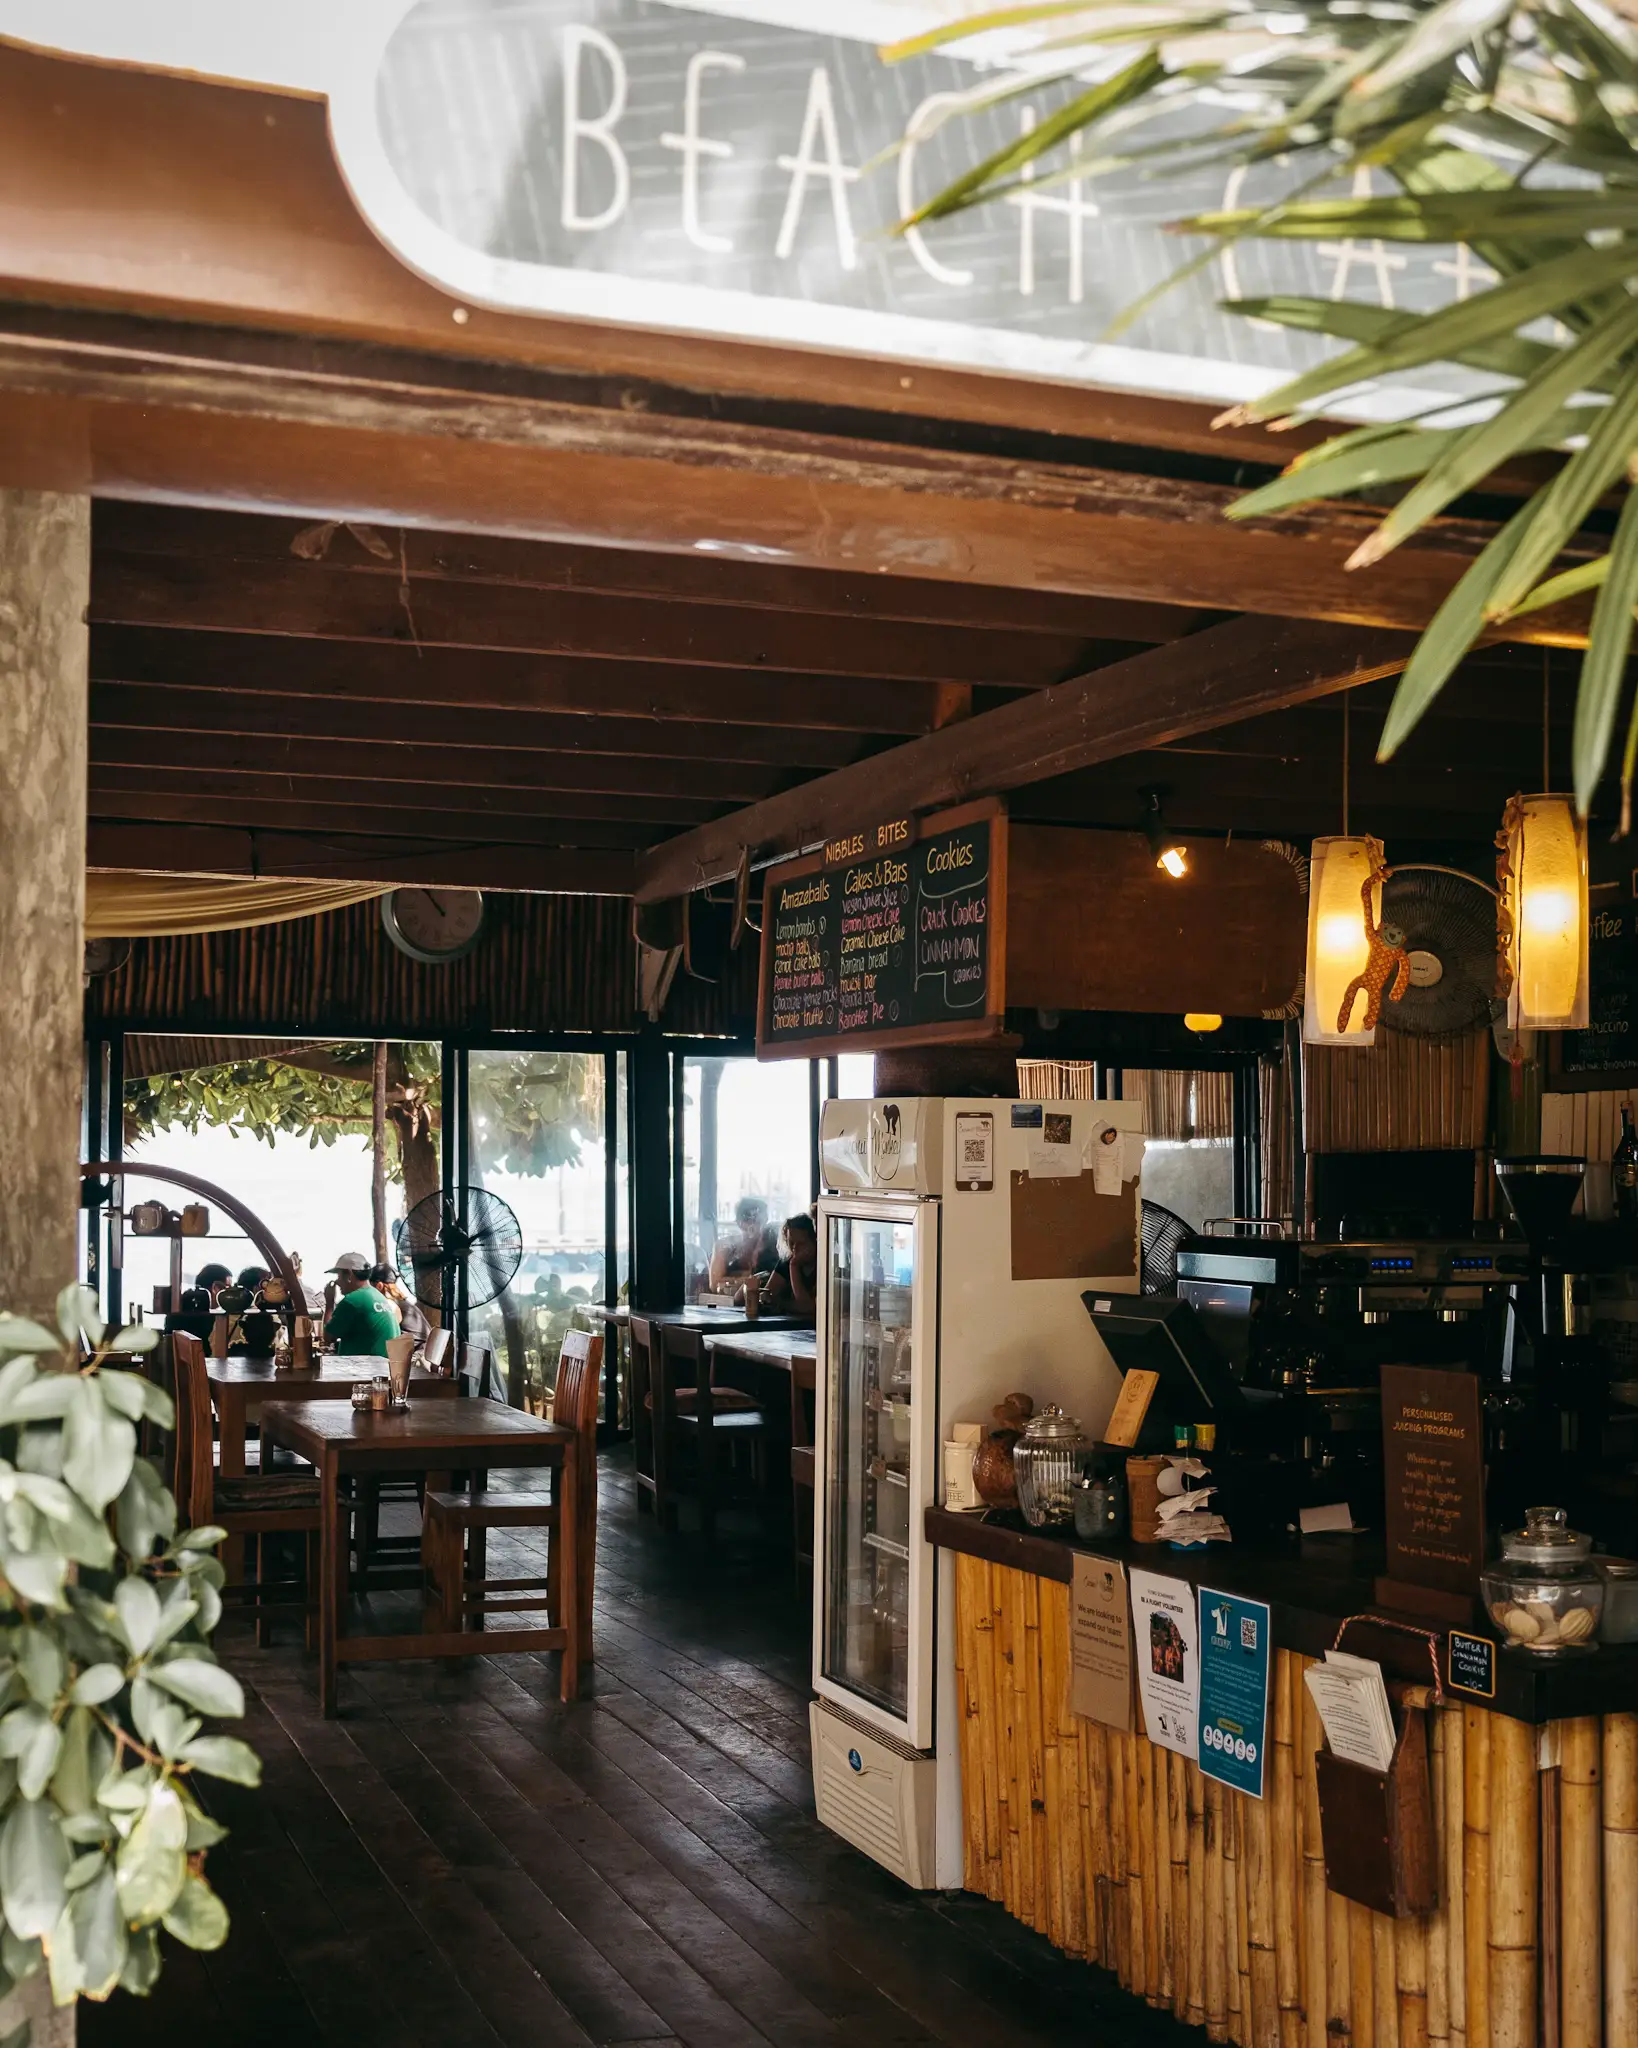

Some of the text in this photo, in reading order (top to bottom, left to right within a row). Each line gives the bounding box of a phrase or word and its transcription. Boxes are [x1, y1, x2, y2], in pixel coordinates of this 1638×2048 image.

[560, 24, 1101, 303] BEACH
[825, 834, 864, 865] NIBBLES
[878, 820, 908, 847] BITES
[926, 839, 974, 875] Cookies
[844, 860, 908, 895] Cakes & Bars
[780, 878, 830, 911] Amazeballs
[840, 924, 906, 954] Caramel Cheese Cake
[840, 946, 888, 977] Banana bread
[864, 972, 877, 990] bar
[872, 1002, 885, 1025] Pie
[1402, 1406, 1454, 1422] PERSONALISED
[1423, 1424, 1466, 1439] PROGRAMS
[1077, 1603, 1123, 1624] We are looking to
[1162, 1602, 1184, 1614] VOLUNTEER
[1077, 1618, 1096, 1630] expand
[1096, 1624, 1106, 1633] our
[1454, 1636, 1482, 1653] BUTTER
[1452, 1649, 1488, 1666] CINNAMON
[1458, 1661, 1486, 1676] COOKIE
